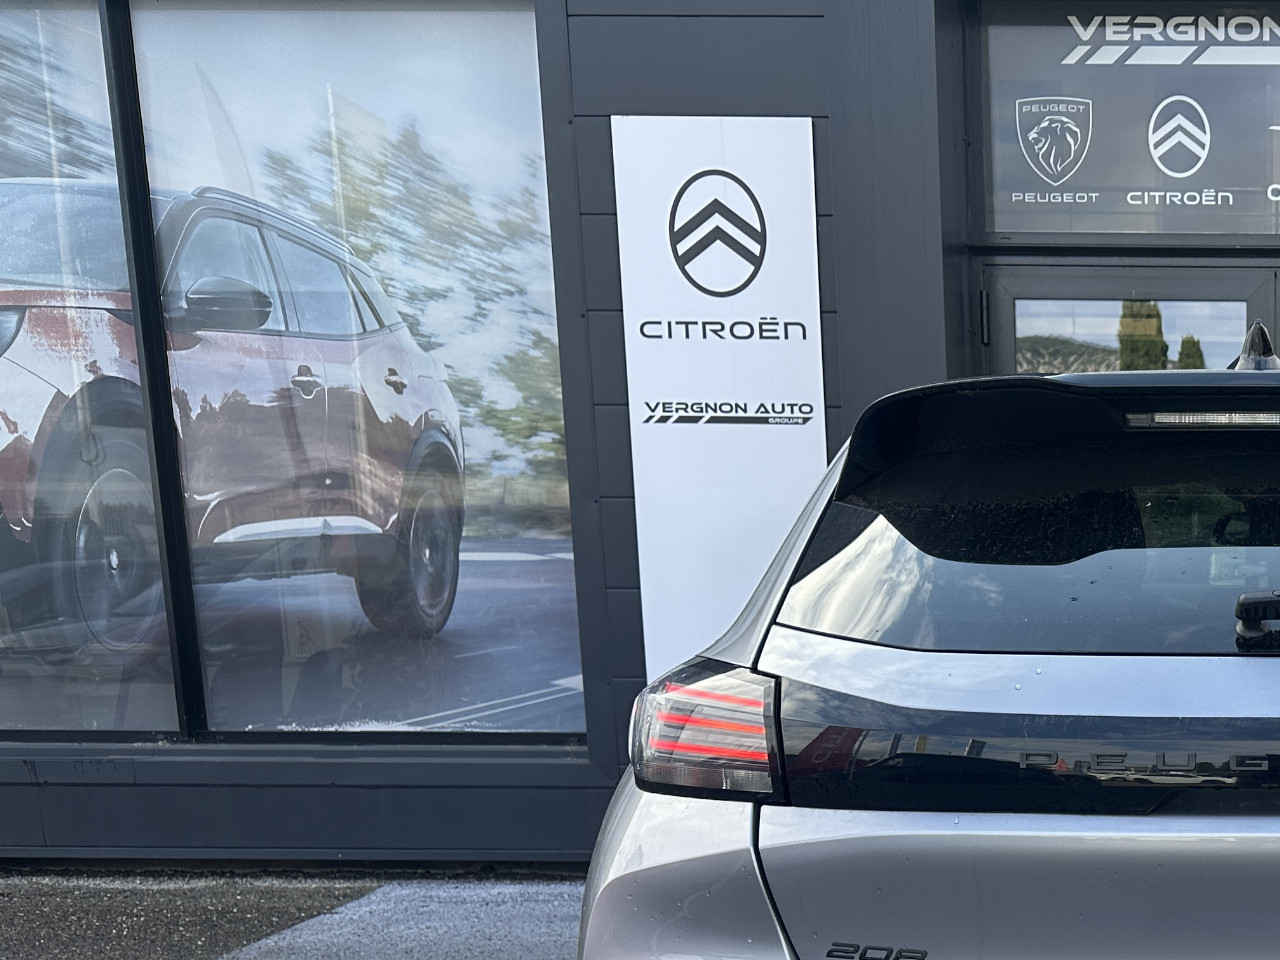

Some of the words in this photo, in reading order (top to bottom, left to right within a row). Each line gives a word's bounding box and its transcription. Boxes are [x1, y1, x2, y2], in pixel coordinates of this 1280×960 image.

[1022, 103, 1086, 114] PEUGEOT
[1011, 192, 1100, 204] PEUGEOT
[644, 401, 748, 414] VERGNON
[754, 402, 815, 415] AUTO
